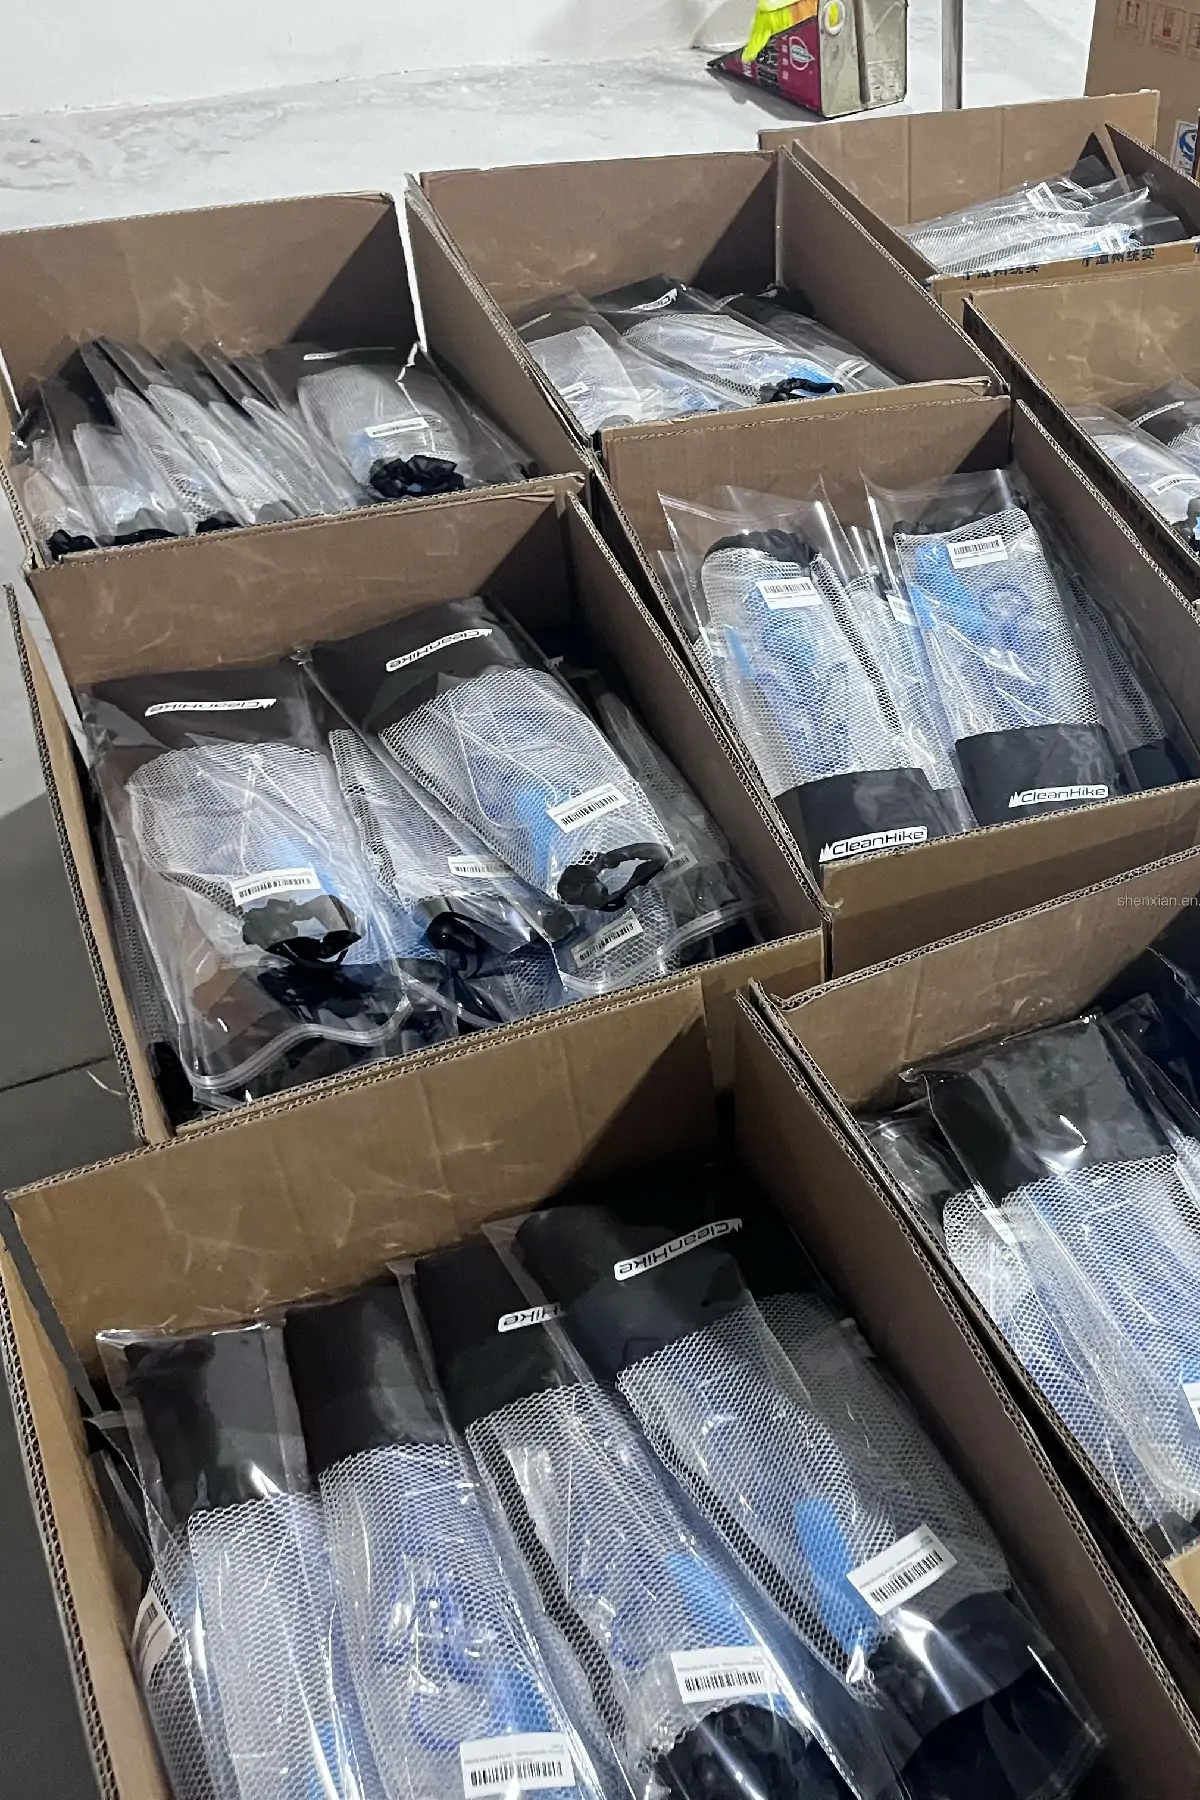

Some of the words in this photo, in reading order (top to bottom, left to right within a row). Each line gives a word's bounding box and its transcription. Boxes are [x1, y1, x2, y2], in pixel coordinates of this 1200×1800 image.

[389, 630, 480, 668] CleanHike
[149, 700, 261, 714] CleanHike
[1021, 786, 1107, 804] CleanHike
[831, 828, 925, 856] CleanHike
[619, 1222, 730, 1275] CleanHike
